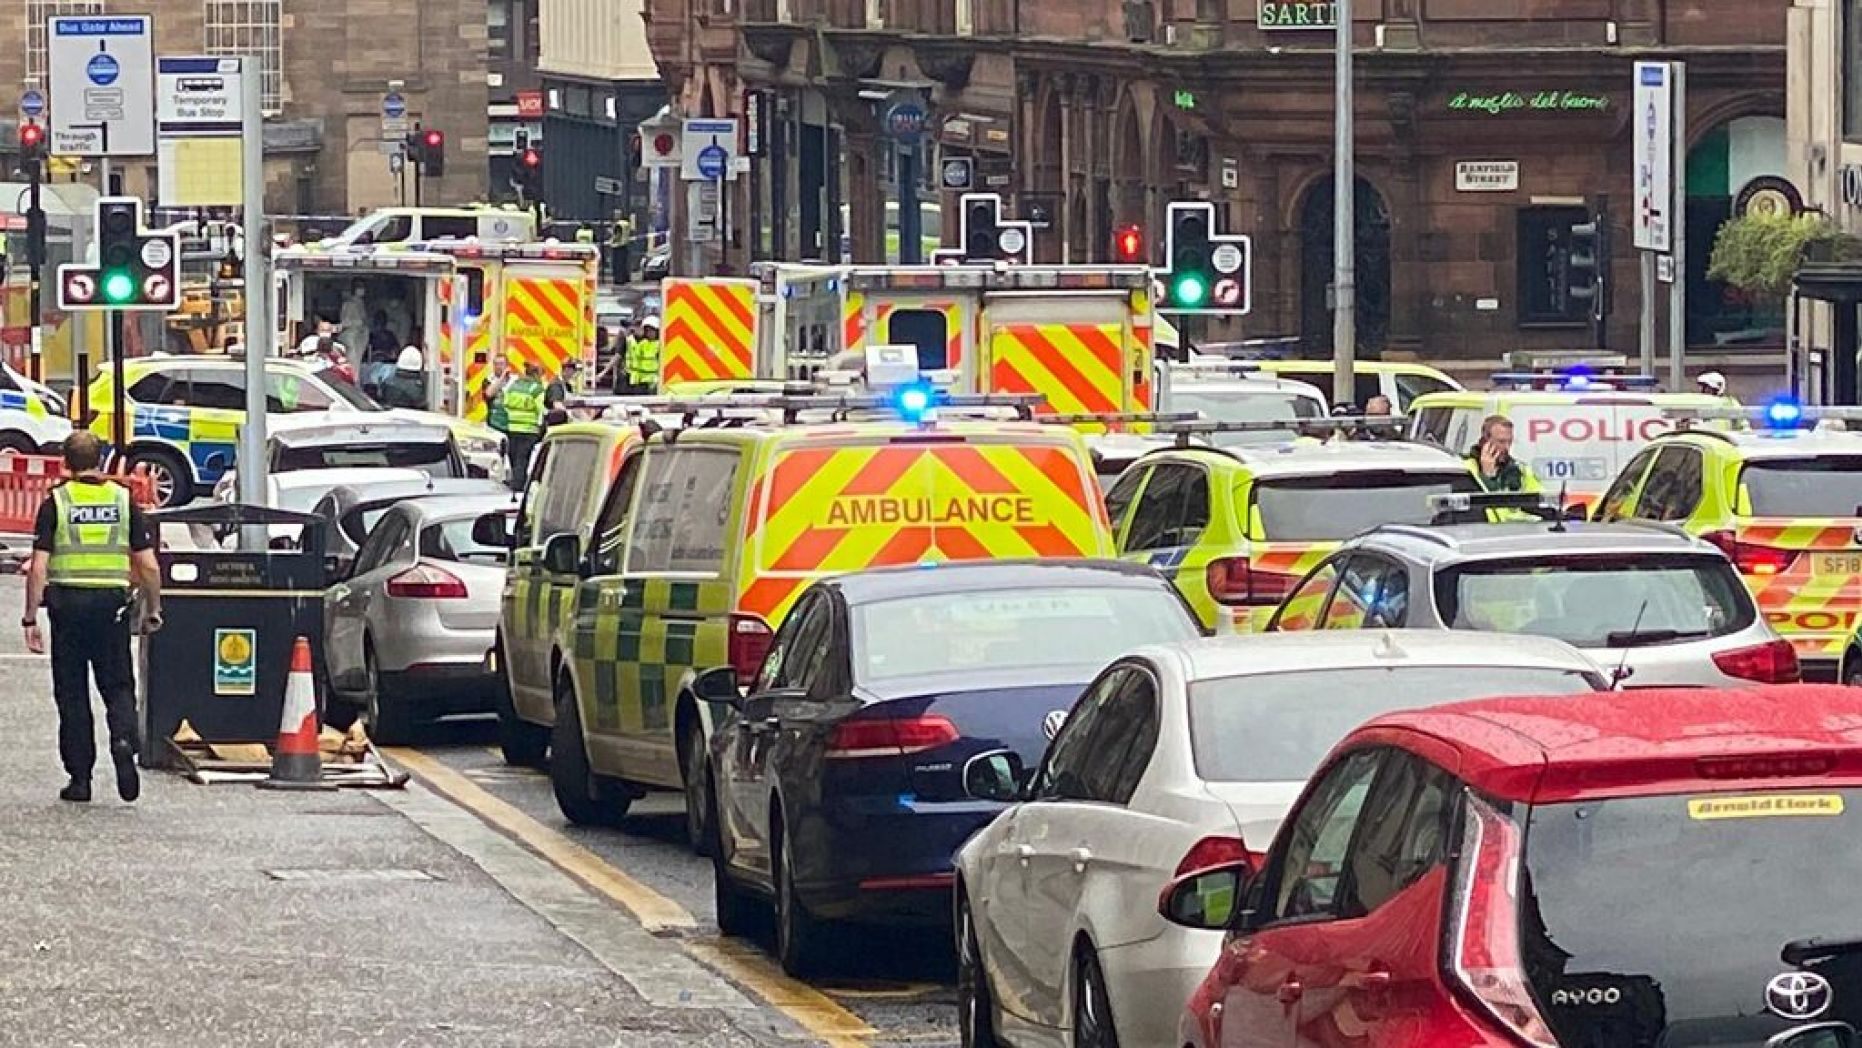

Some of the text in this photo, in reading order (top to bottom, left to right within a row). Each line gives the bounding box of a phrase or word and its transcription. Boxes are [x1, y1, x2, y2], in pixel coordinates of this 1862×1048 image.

[1263, 3, 1337, 24] SARTI
[59, 21, 141, 33] Bus Gate Ahead
[172, 94, 227, 107] Temporary
[177, 107, 225, 118] Bus Stop
[55, 131, 97, 142] Through
[60, 142, 92, 151] traffic
[1546, 461, 1575, 477] 101
[70, 506, 119, 522] POLICE
[827, 497, 1034, 524] AMBULANCE
[1698, 798, 1831, 813] Arnold Clark
[1551, 987, 1621, 1005] AYGO
